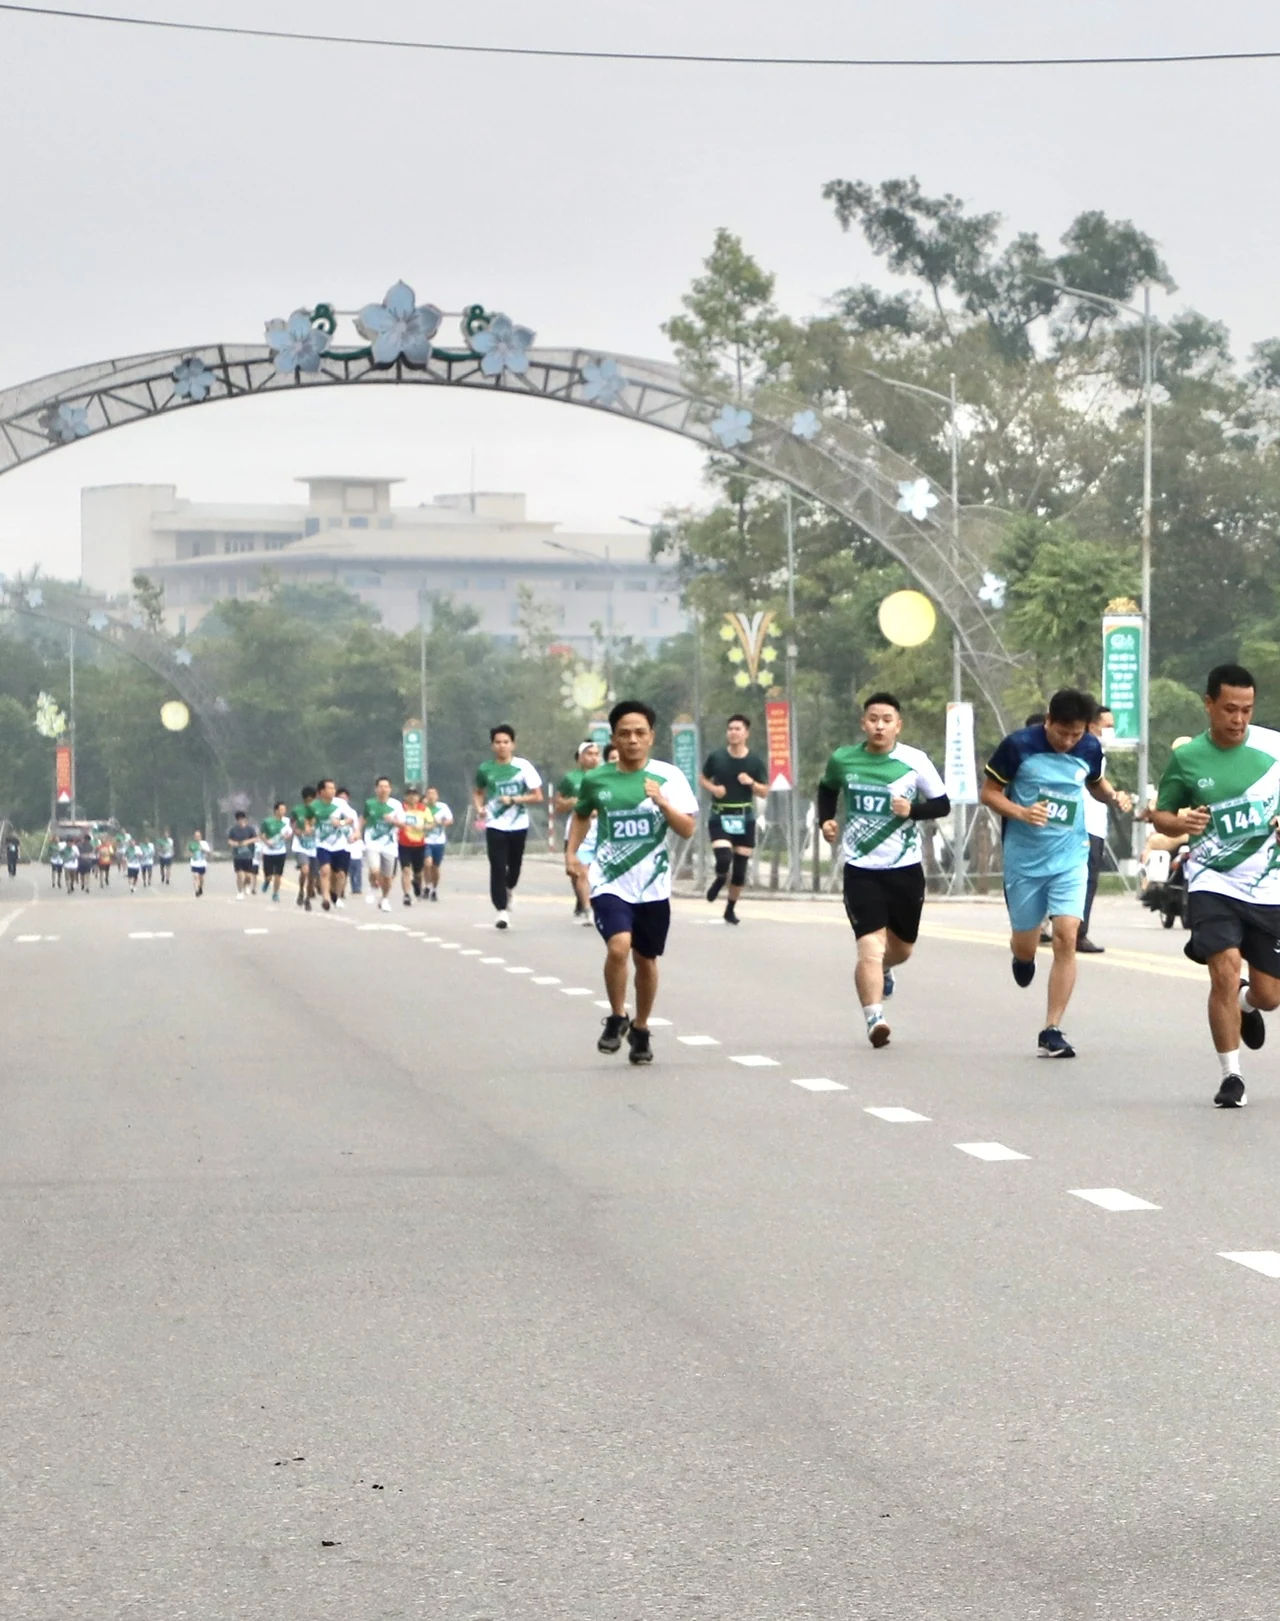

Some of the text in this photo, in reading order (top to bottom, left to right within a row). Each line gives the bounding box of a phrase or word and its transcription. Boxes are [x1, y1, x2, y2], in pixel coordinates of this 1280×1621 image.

[854, 795, 886, 812] 197
[613, 819, 650, 838] 209
[1220, 807, 1261, 834] 144
